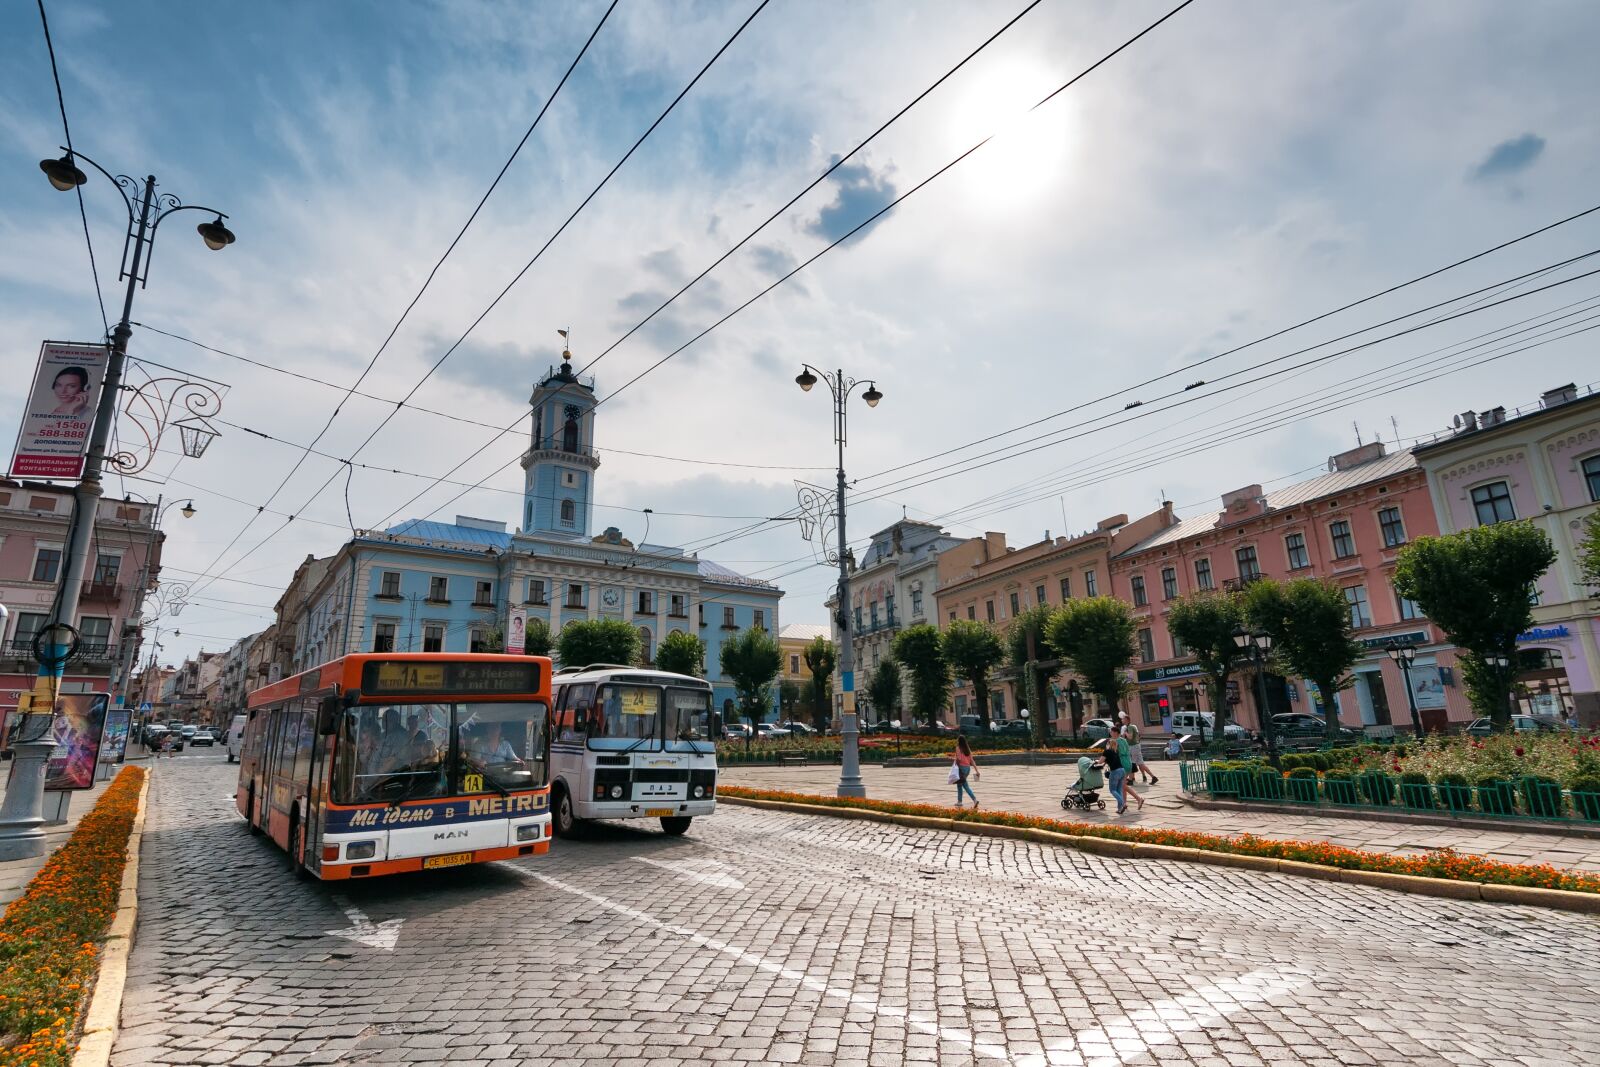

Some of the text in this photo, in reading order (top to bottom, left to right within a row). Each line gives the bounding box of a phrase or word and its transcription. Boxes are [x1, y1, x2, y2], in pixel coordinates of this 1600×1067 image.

[56, 421, 87, 430] 15-80
[39, 429, 85, 439] 588-888
[633, 692, 644, 706] 24
[467, 775, 479, 791] 1A
[468, 793, 547, 816] METRO
[434, 830, 468, 840] MAN
